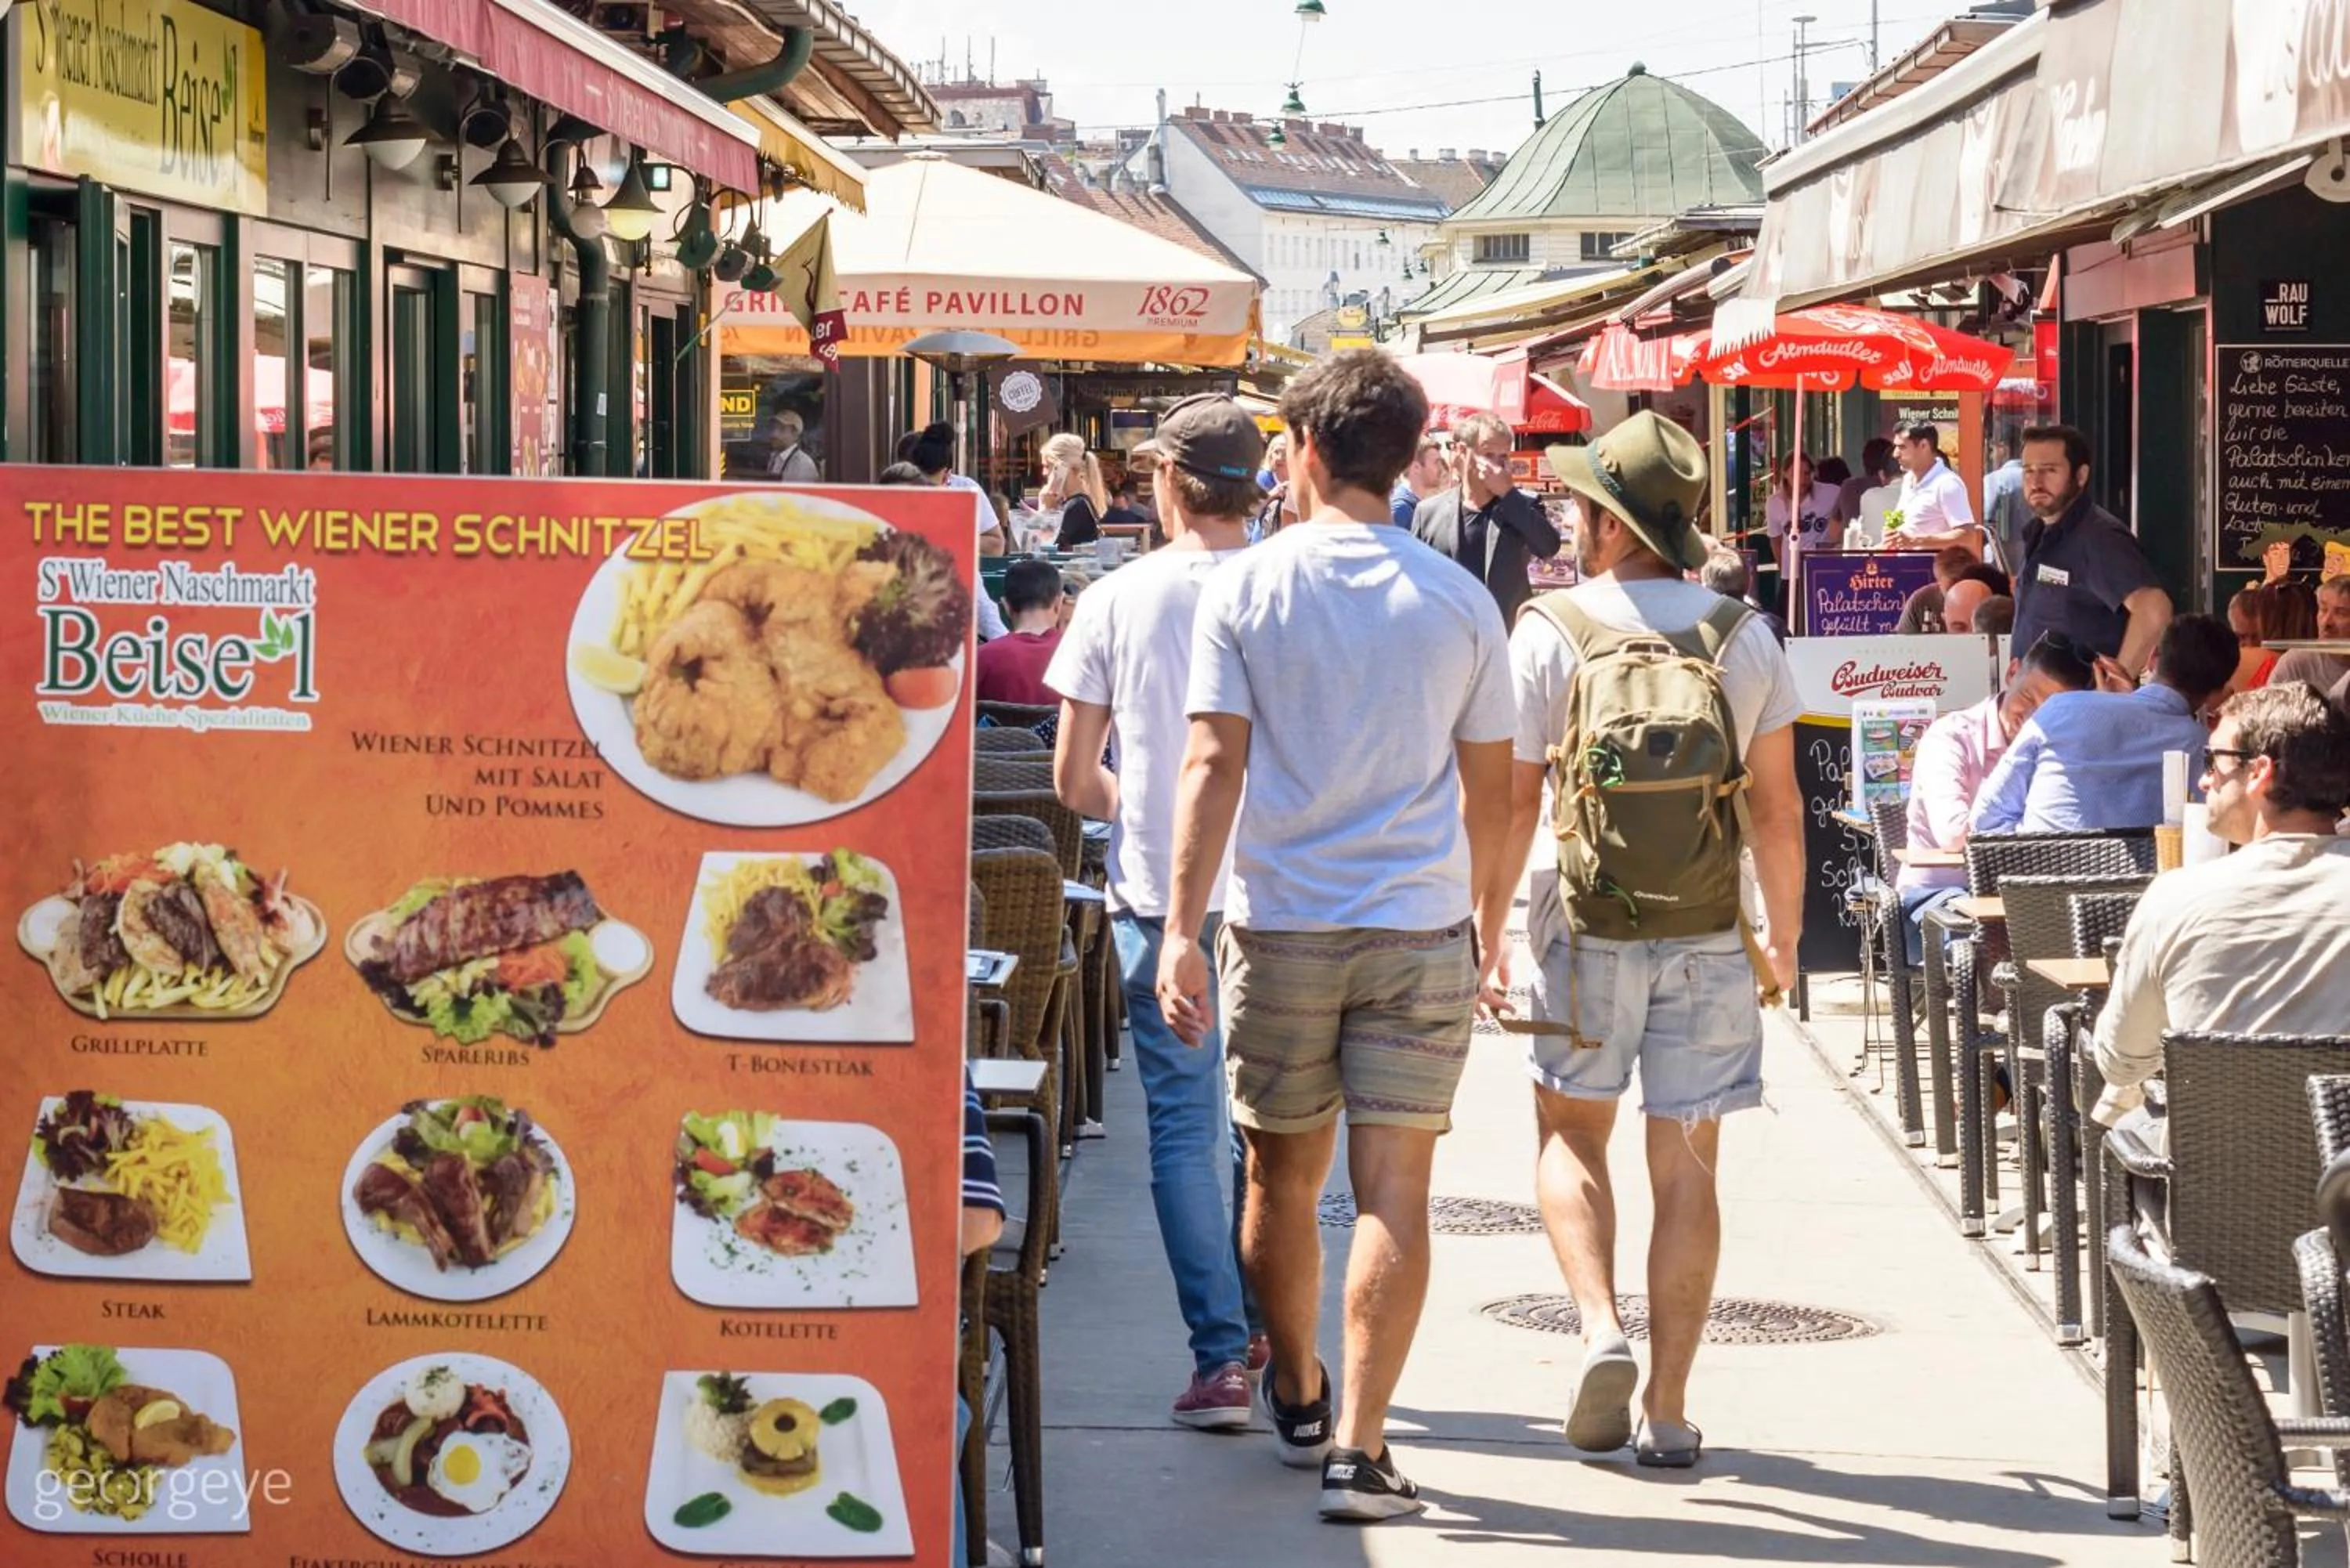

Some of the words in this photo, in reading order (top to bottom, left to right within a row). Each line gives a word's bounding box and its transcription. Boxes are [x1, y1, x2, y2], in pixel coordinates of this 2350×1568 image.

[927, 291, 1084, 316] PAVILLON
[1137, 285, 1209, 316] 1862
[1147, 316, 1198, 327] PREMIUM
[2265, 305, 2308, 326] WOLF
[1759, 339, 1883, 368] Almdudler
[2229, 373, 2278, 396] Liebe
[1899, 406, 1930, 421] Wiener
[2227, 401, 2278, 425] gerne
[2284, 398, 2348, 419] bereiten
[2261, 425, 2289, 443] die
[2277, 469, 2308, 491] mit
[25, 501, 111, 544] THE
[124, 503, 244, 549] BEST
[258, 508, 441, 555] WIENER
[454, 512, 714, 561] SCHNITZEL
[164, 563, 313, 605] Naschmarkt
[1849, 573, 1895, 591] Hirter
[1820, 612, 1870, 636] gefüllt
[1831, 659, 1948, 698] Budweiser
[351, 731, 455, 755] WIENER
[1809, 739, 1852, 782] Pal
[475, 768, 521, 787] MIT
[532, 768, 604, 790] SALAT
[425, 794, 486, 817] UND
[496, 796, 605, 819] POMMES
[70, 1035, 209, 1058] GRILLPLATTE
[421, 1046, 531, 1067] SPARERIBS
[726, 1054, 874, 1077] T-BONESTEAK
[101, 1300, 165, 1321] STEAK
[366, 1307, 548, 1332] LAMMKOTELETTE
[719, 1319, 839, 1340] KOTELETTE
[1293, 1420, 1323, 1438] NIKE
[1326, 1463, 1358, 1480] NIKE
[92, 1548, 188, 1568] SCHOLLE
